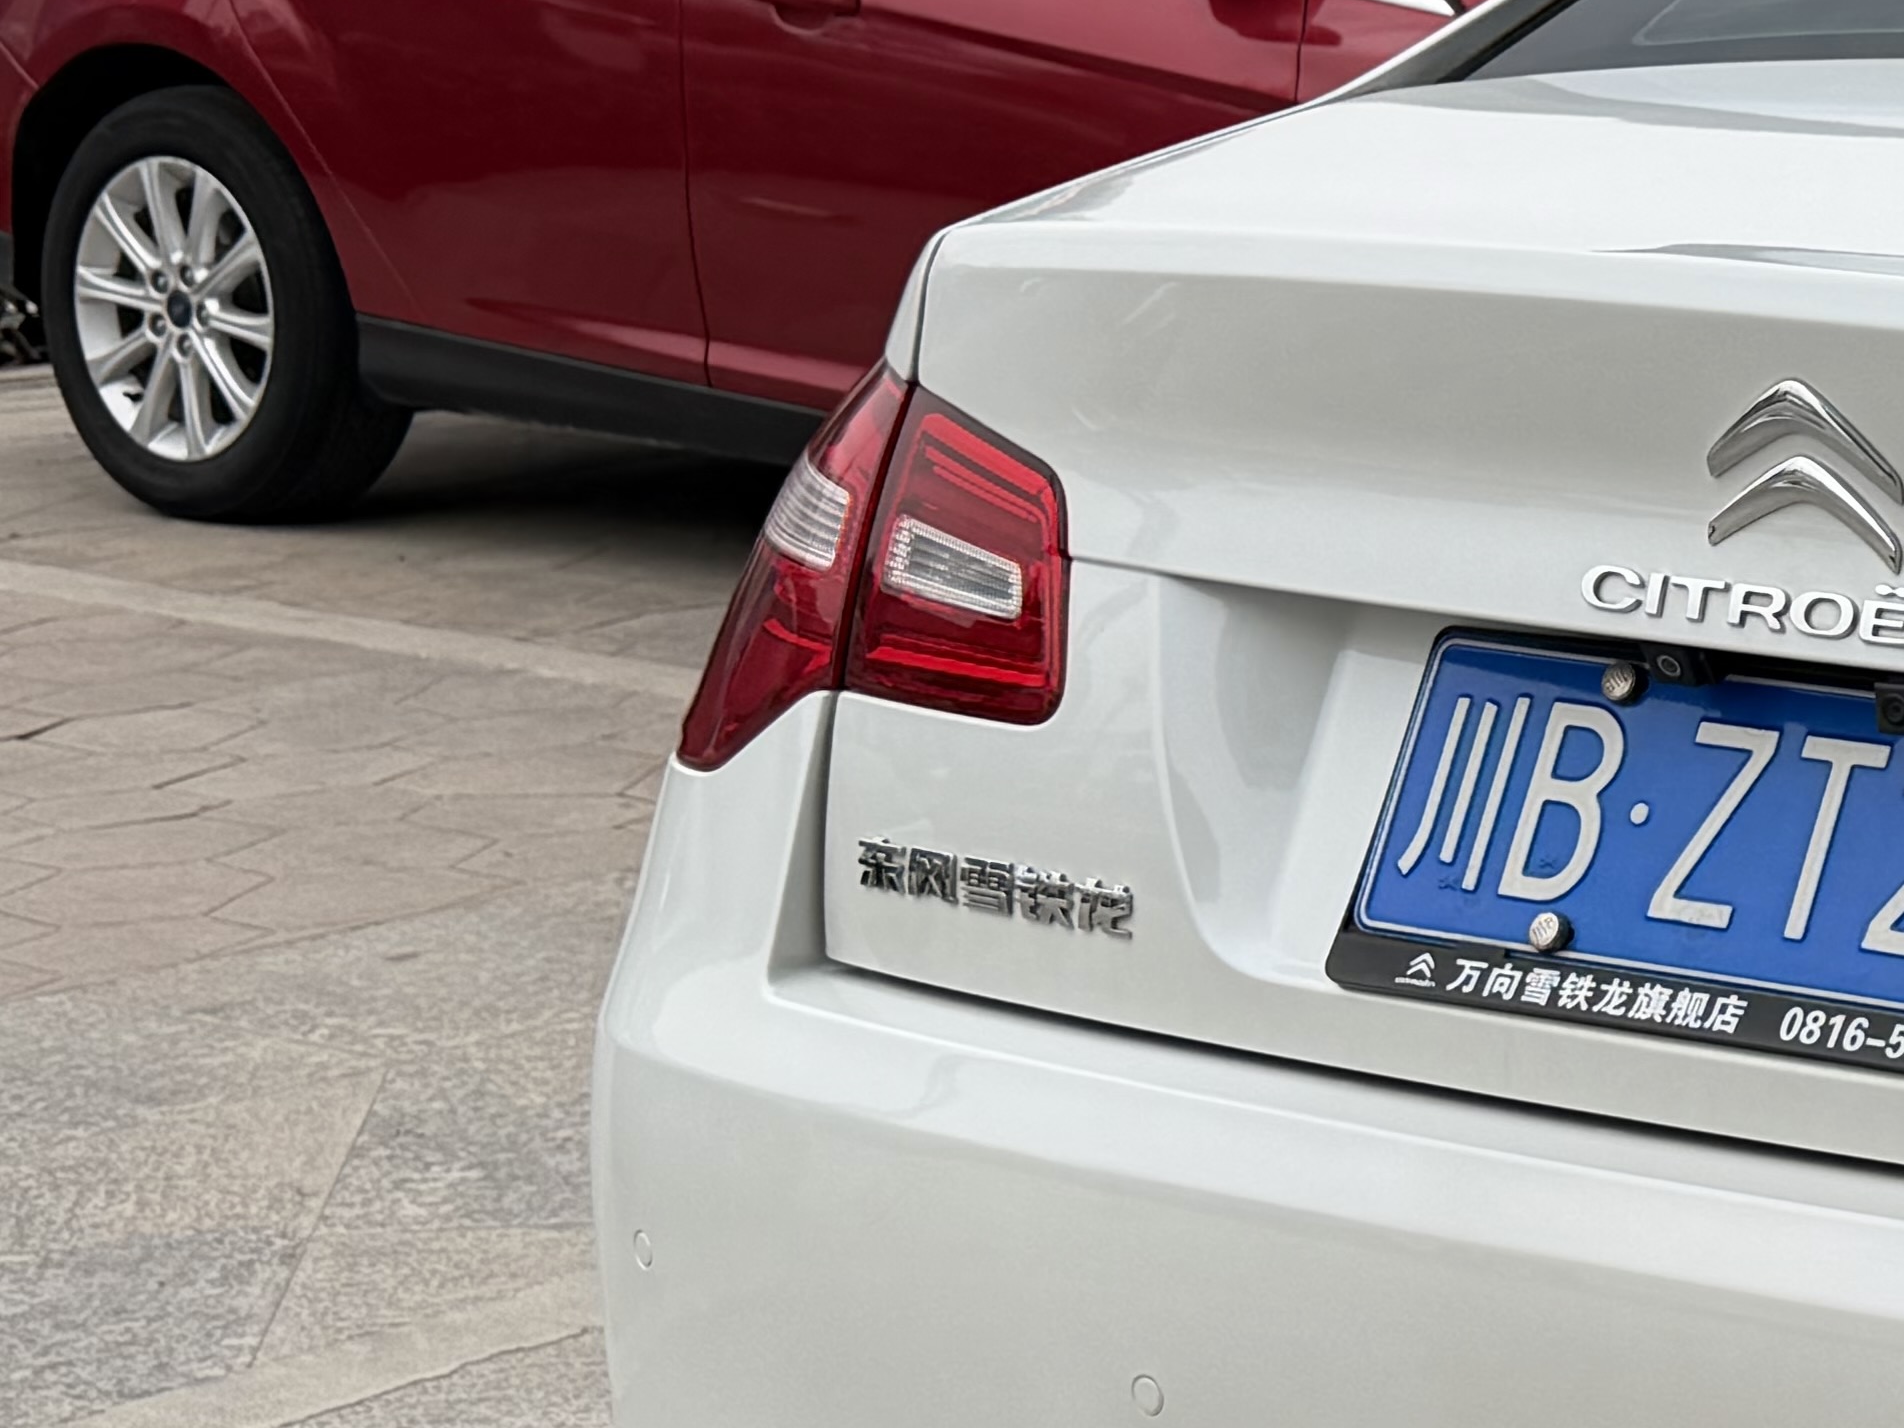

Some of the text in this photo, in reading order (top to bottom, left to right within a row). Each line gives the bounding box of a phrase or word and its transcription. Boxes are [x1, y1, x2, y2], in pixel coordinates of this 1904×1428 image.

[1445, 957, 1749, 1035] 万向雪铁龙旗舰店
